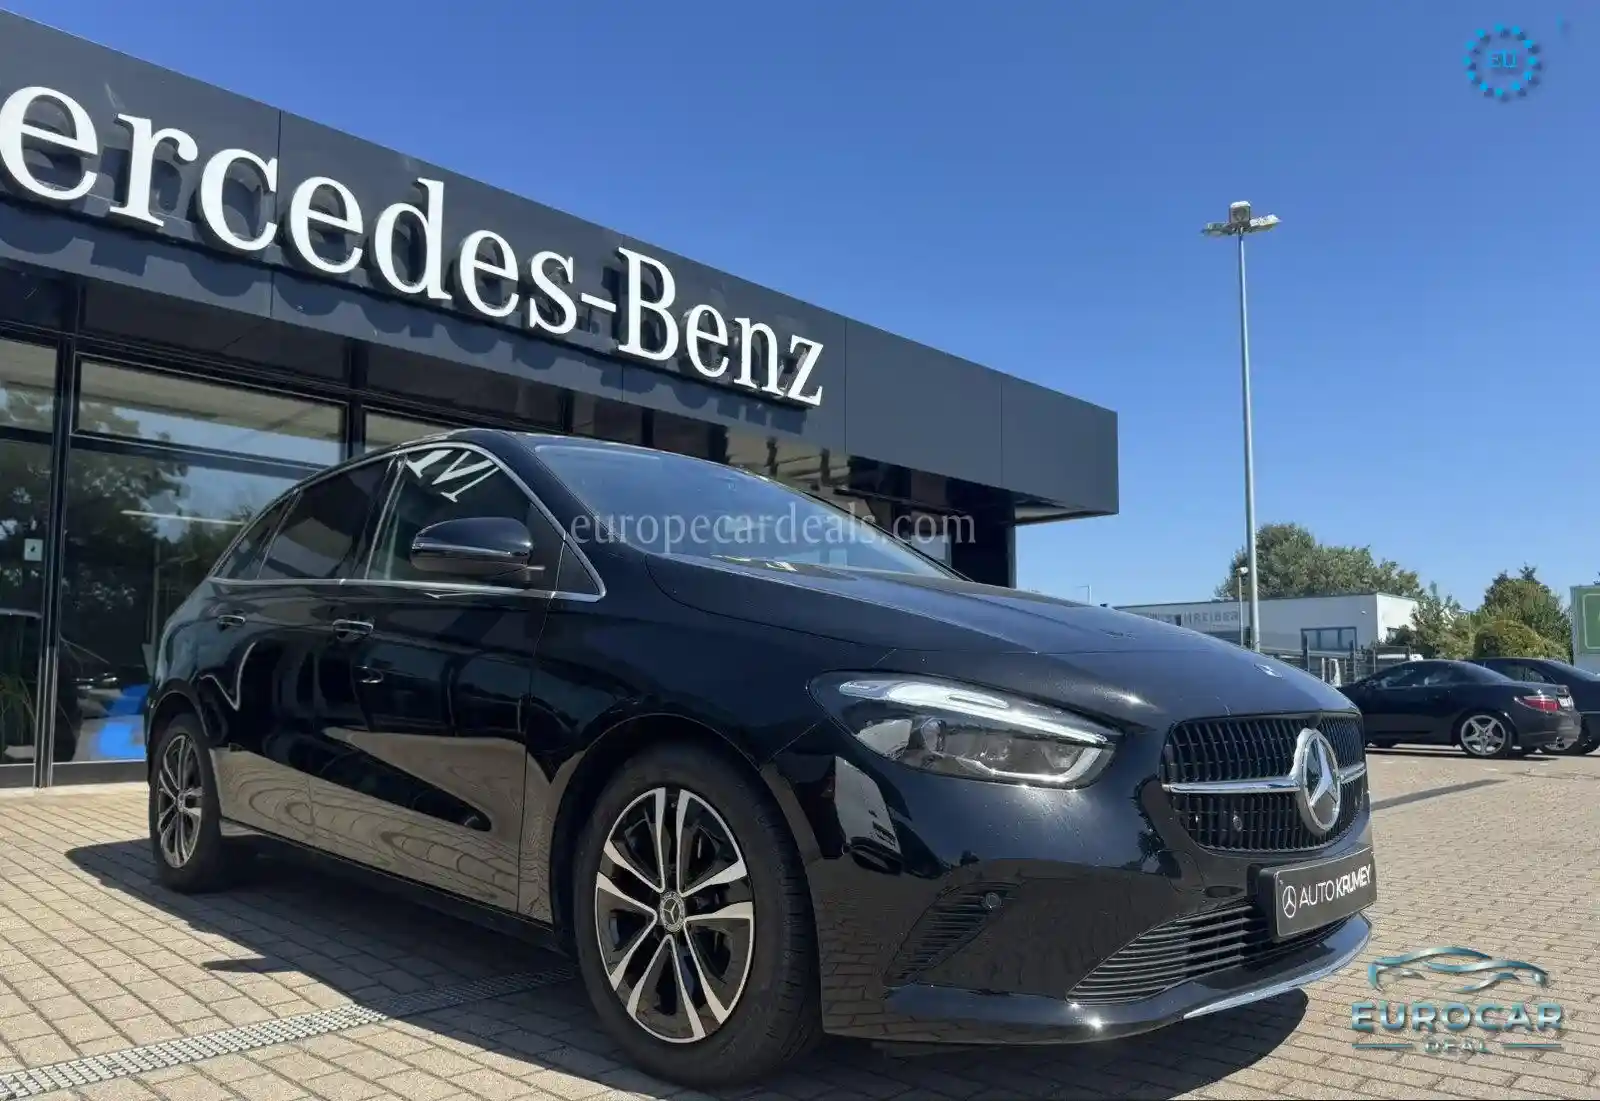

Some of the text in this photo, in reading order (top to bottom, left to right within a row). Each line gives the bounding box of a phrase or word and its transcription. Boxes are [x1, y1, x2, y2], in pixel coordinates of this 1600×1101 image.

[0, 86, 824, 407] ercedes-Benz
[1299, 863, 1371, 909] AUTO KRUMEY
